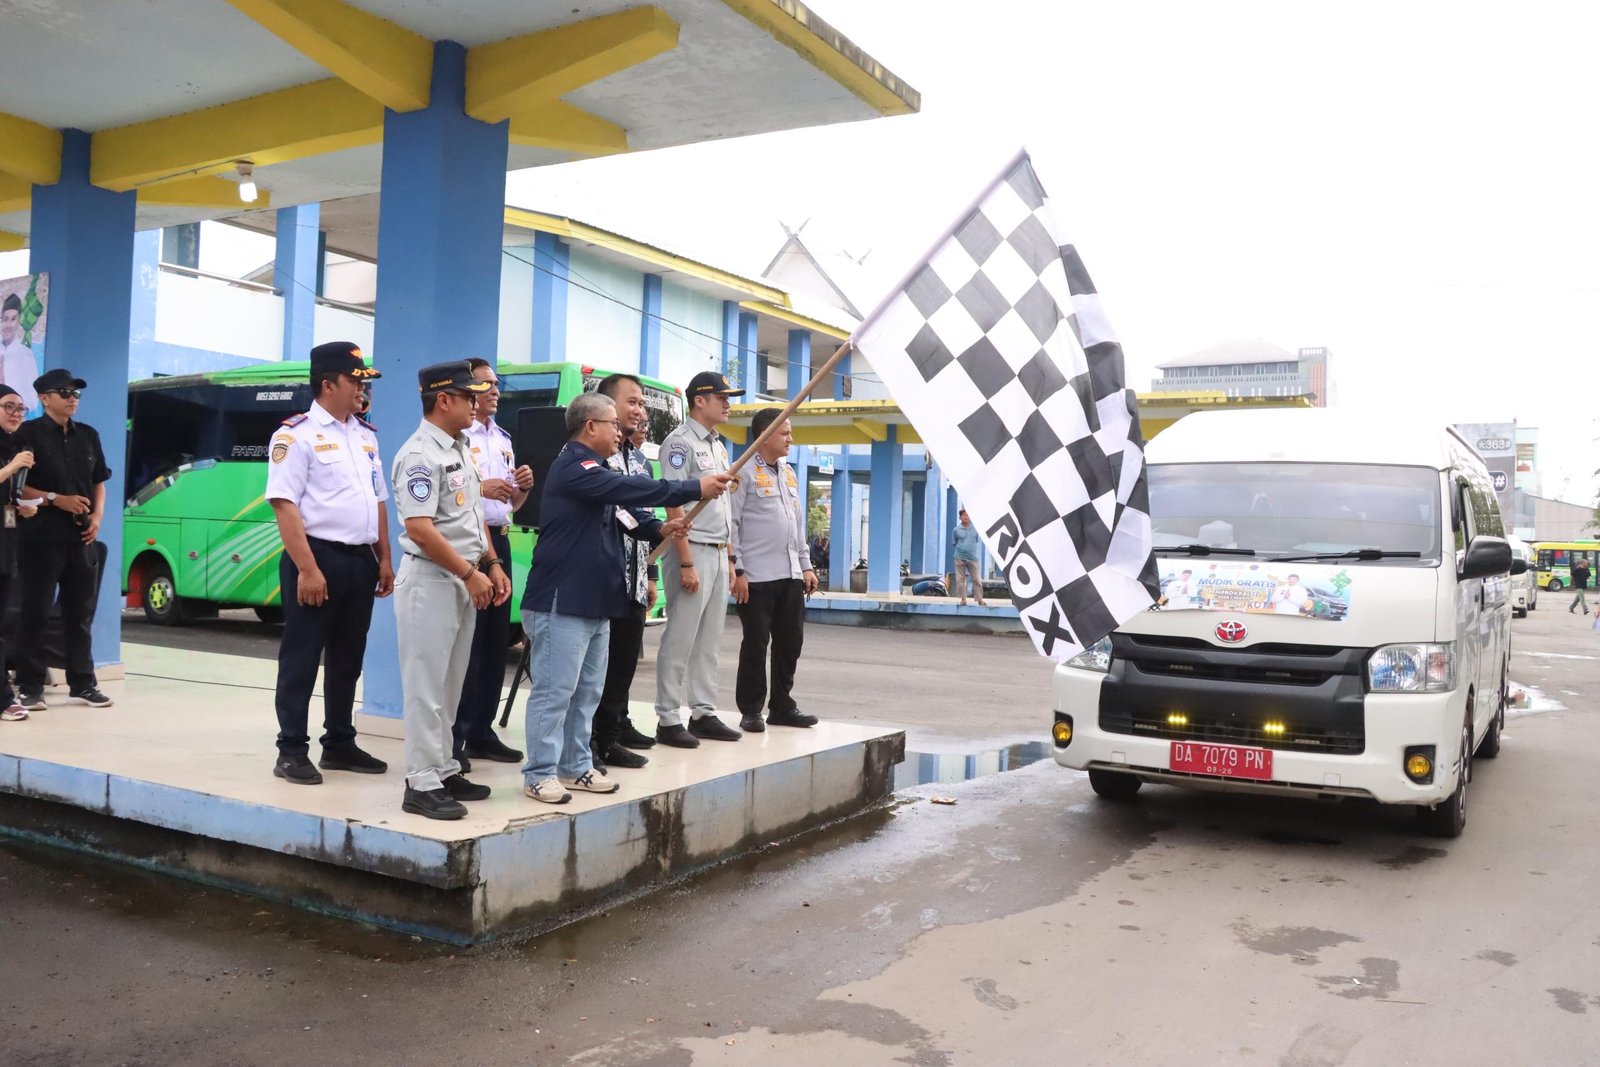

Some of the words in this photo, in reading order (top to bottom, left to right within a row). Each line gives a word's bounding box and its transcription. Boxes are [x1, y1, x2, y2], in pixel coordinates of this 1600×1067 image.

[985, 512, 1075, 656] ROX
[1237, 580, 1276, 588] GRATIS
[1175, 743, 1192, 762] DA
[1202, 746, 1238, 767] 7079
[1245, 750, 1264, 769] PN
